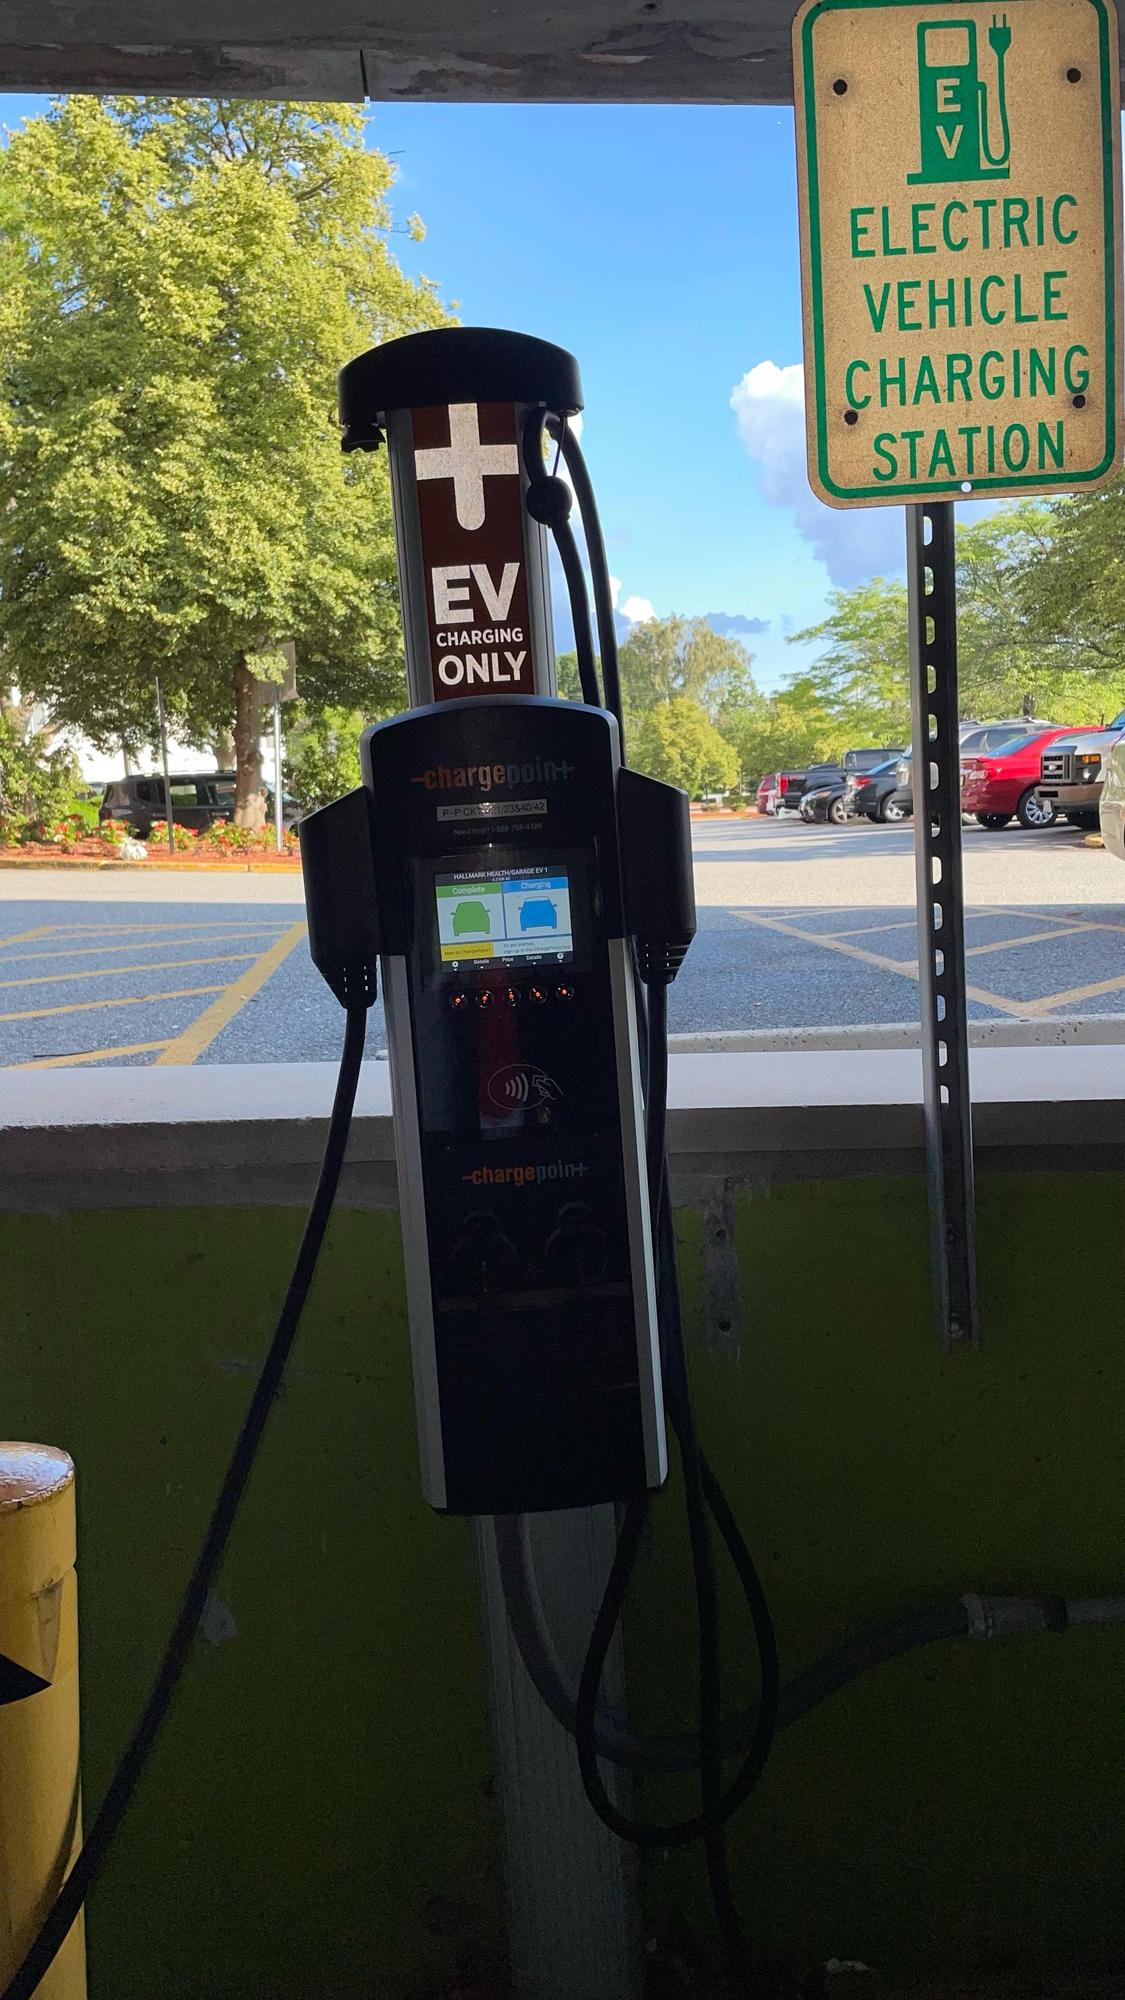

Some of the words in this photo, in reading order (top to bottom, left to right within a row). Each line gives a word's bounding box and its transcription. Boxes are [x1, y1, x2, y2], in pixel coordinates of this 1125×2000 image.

[850, 194, 1078, 258] ELECTRIC
[863, 271, 1068, 333] VEHICLE
[845, 345, 1090, 410] CHARGING
[872, 421, 1064, 482] STATION
[431, 562, 520, 625] EV
[436, 628, 523, 647] CHARGING
[438, 651, 527, 685] ONLY
[452, 886, 485, 895] Complete
[453, 872, 486, 880] HALLMARK
[521, 881, 552, 889] Charging
